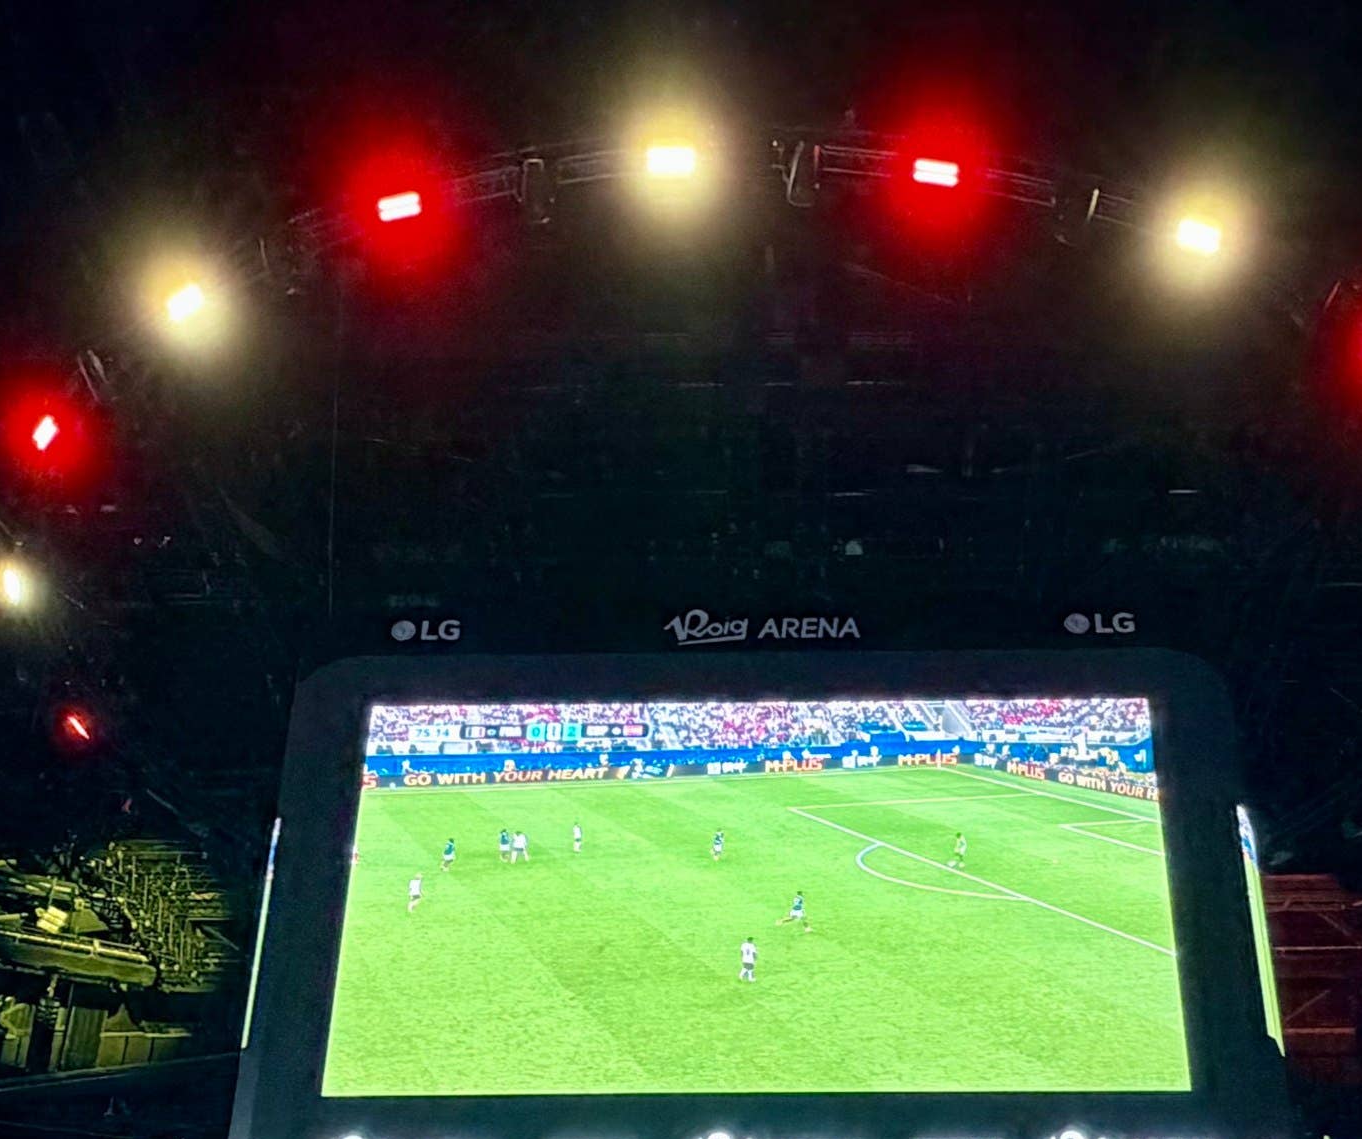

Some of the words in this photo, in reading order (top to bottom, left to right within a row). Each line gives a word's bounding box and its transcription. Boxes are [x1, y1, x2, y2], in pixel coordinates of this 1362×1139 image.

[421, 620, 461, 640] LG
[664, 609, 749, 645] Roig
[757, 617, 860, 638] ARENA
[1094, 612, 1135, 633] LG
[404, 774, 431, 787] GO
[437, 772, 486, 785] WITH
[494, 769, 543, 783] YOUR
[548, 767, 608, 780] HEART
[1076, 774, 1107, 792] WITH
[1110, 777, 1145, 797] YOUR
